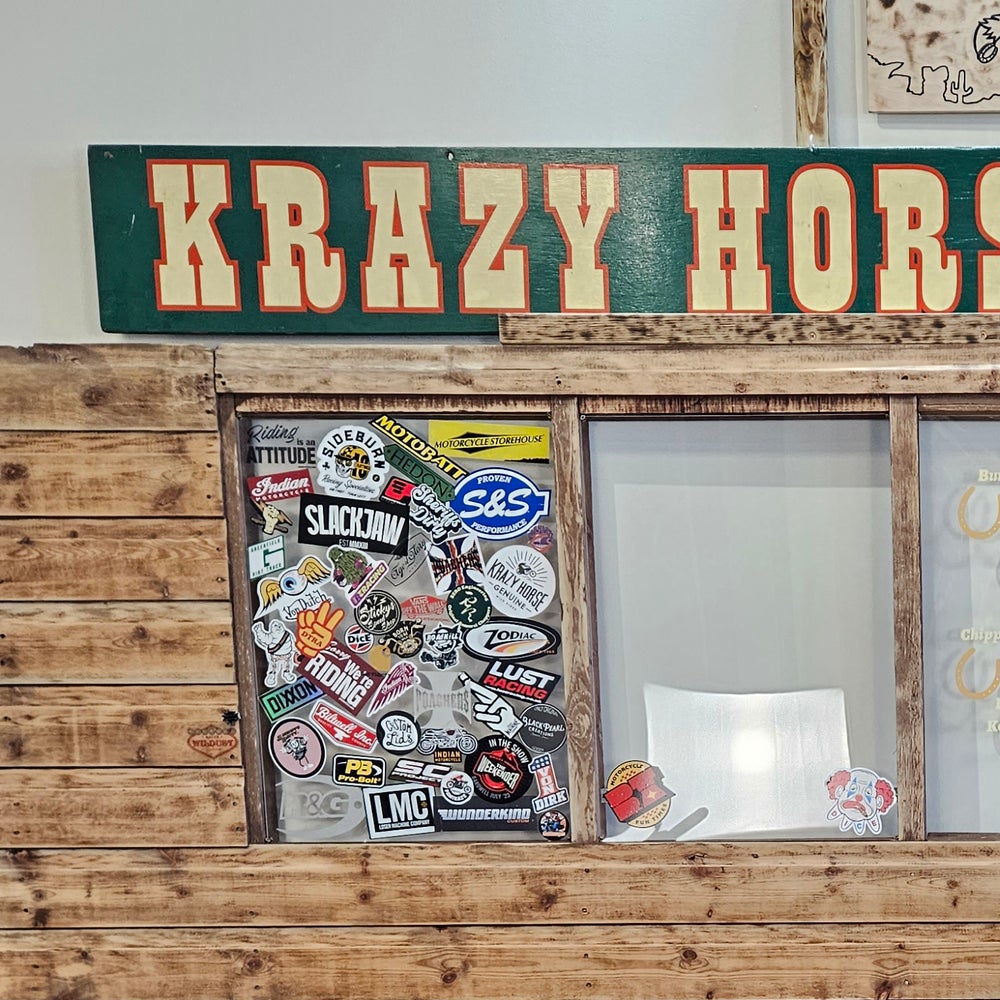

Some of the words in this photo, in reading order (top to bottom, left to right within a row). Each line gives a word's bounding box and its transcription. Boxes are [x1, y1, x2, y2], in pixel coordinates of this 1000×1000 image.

[146, 158, 619, 313] KRAZY
[247, 424, 300, 443] Riding
[434, 438, 489, 449] MOTORCYCLE
[490, 434, 543, 445] STOREHOUSE
[247, 446, 317, 465] ATTITUDE
[322, 429, 386, 470] SIDEBURN
[375, 415, 467, 481] MOTOBATT
[391, 449, 449, 498] HEDON
[477, 474, 513, 485] PROVEN
[252, 476, 311, 497] Indian
[255, 488, 309, 502] MOTORCYCLE
[460, 488, 532, 519] S&S
[304, 504, 406, 547] SLACKJAW
[409, 505, 447, 539] Dirty
[470, 517, 528, 535] PERFORMANCE
[250, 539, 281, 553] GREENFIELD
[266, 563, 283, 573] TRACK
[487, 559, 520, 589] KRAZY
[516, 581, 549, 612] HORSE
[493, 584, 527, 610] GENUINE
[283, 604, 301, 619] Von
[299, 590, 331, 612] Dutch
[301, 630, 323, 648] DTRA
[425, 632, 462, 642] ROADKILL
[484, 629, 537, 651] ZODIAC
[304, 652, 367, 708] RIDING
[344, 659, 374, 689] We're
[488, 660, 555, 689] LUST
[266, 680, 319, 714] DIXXON
[483, 674, 549, 700] RACING
[315, 706, 357, 734] Biltwell
[522, 716, 543, 730] BLACK
[542, 722, 565, 732] PEARL
[386, 732, 413, 747] Lids
[488, 738, 498, 748] IN
[498, 738, 511, 750] THE
[511, 743, 530, 764] SHOW
[345, 759, 374, 776] PB
[391, 771, 442, 783] PROJECT
[393, 759, 451, 778] SC
[476, 755, 520, 790] WEEKENDER
[609, 763, 644, 786] MOTORCYCLE
[540, 766, 556, 798] VON
[373, 790, 429, 825] LMC
[535, 790, 568, 812] DIRK
[410, 820, 430, 828] COMPANY
[438, 808, 531, 821] WUNDERKIND
[635, 817, 651, 826] FUN
[651, 802, 669, 824] TIMES
